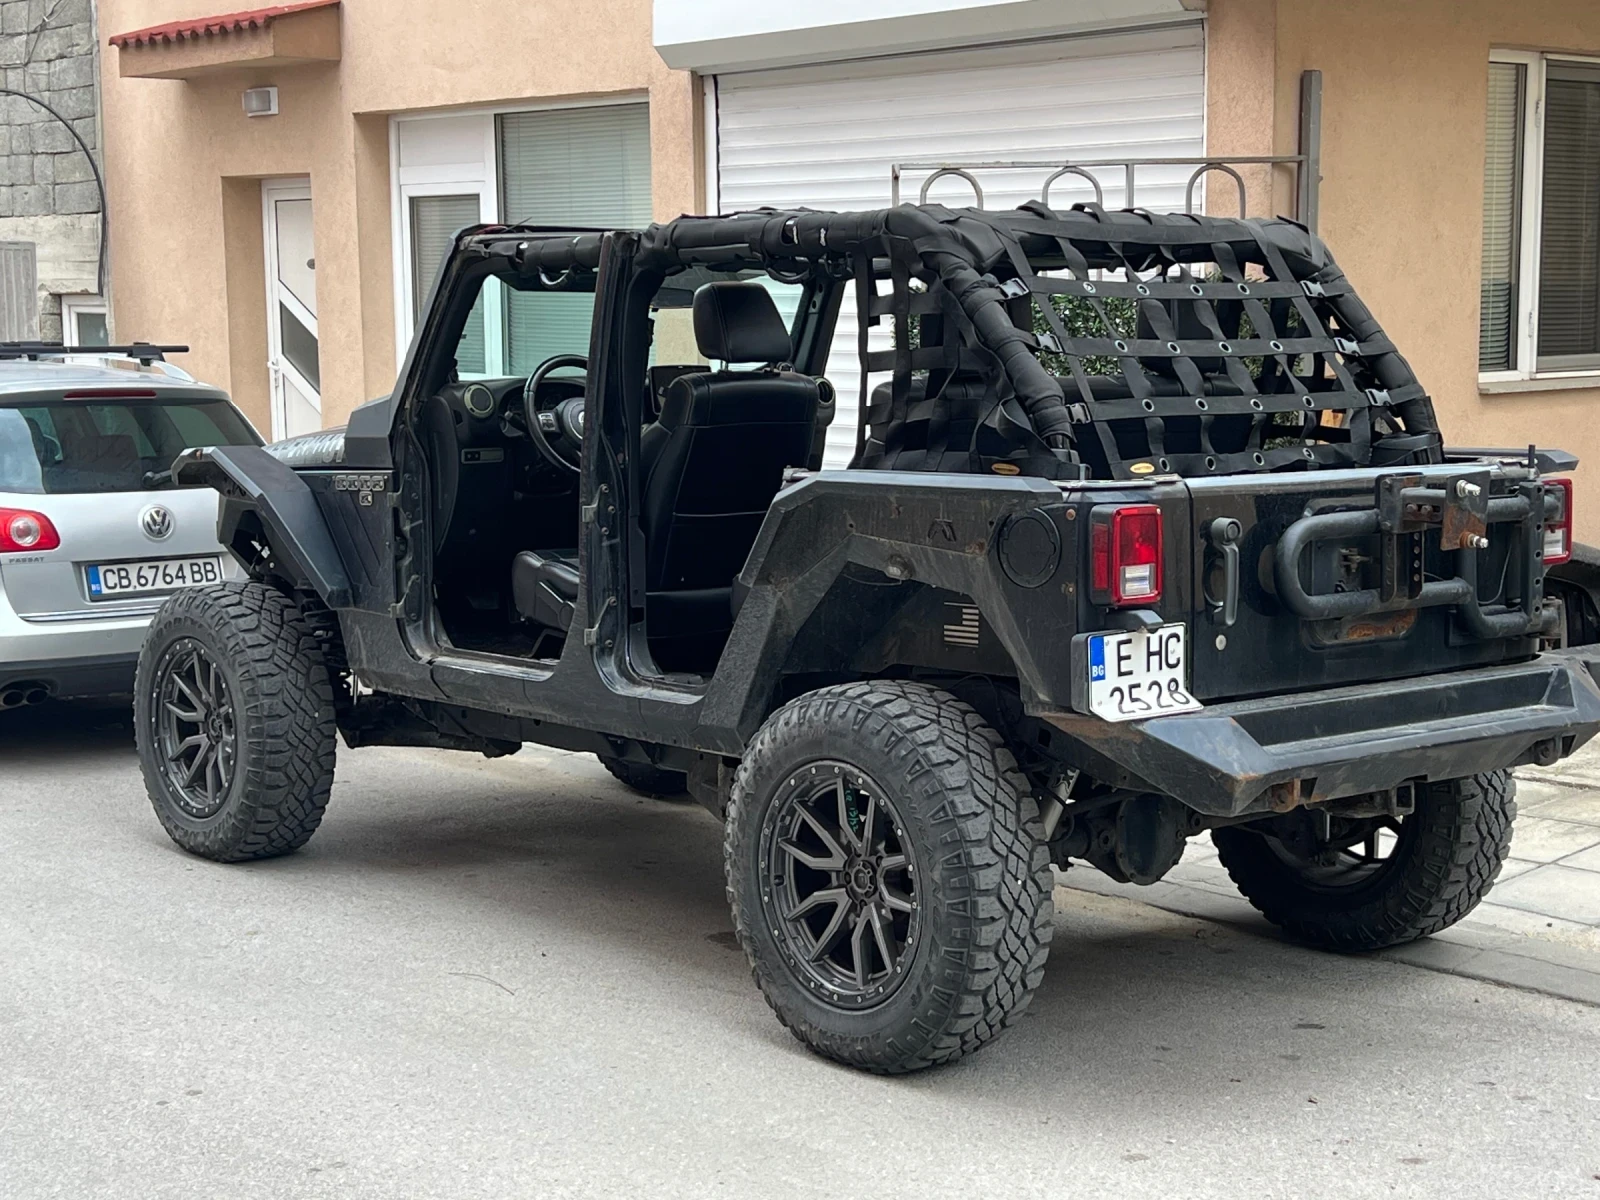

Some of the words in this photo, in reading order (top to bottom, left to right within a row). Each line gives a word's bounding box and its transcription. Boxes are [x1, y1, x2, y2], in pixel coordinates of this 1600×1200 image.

[91, 583, 100, 591] BG
[103, 567, 132, 589] CB
[136, 563, 187, 588] 6764
[190, 561, 217, 583] BB
[1117, 638, 1133, 677] E
[1146, 632, 1181, 672] HC
[1092, 665, 1104, 677] BG
[1109, 677, 1190, 714] 2528
